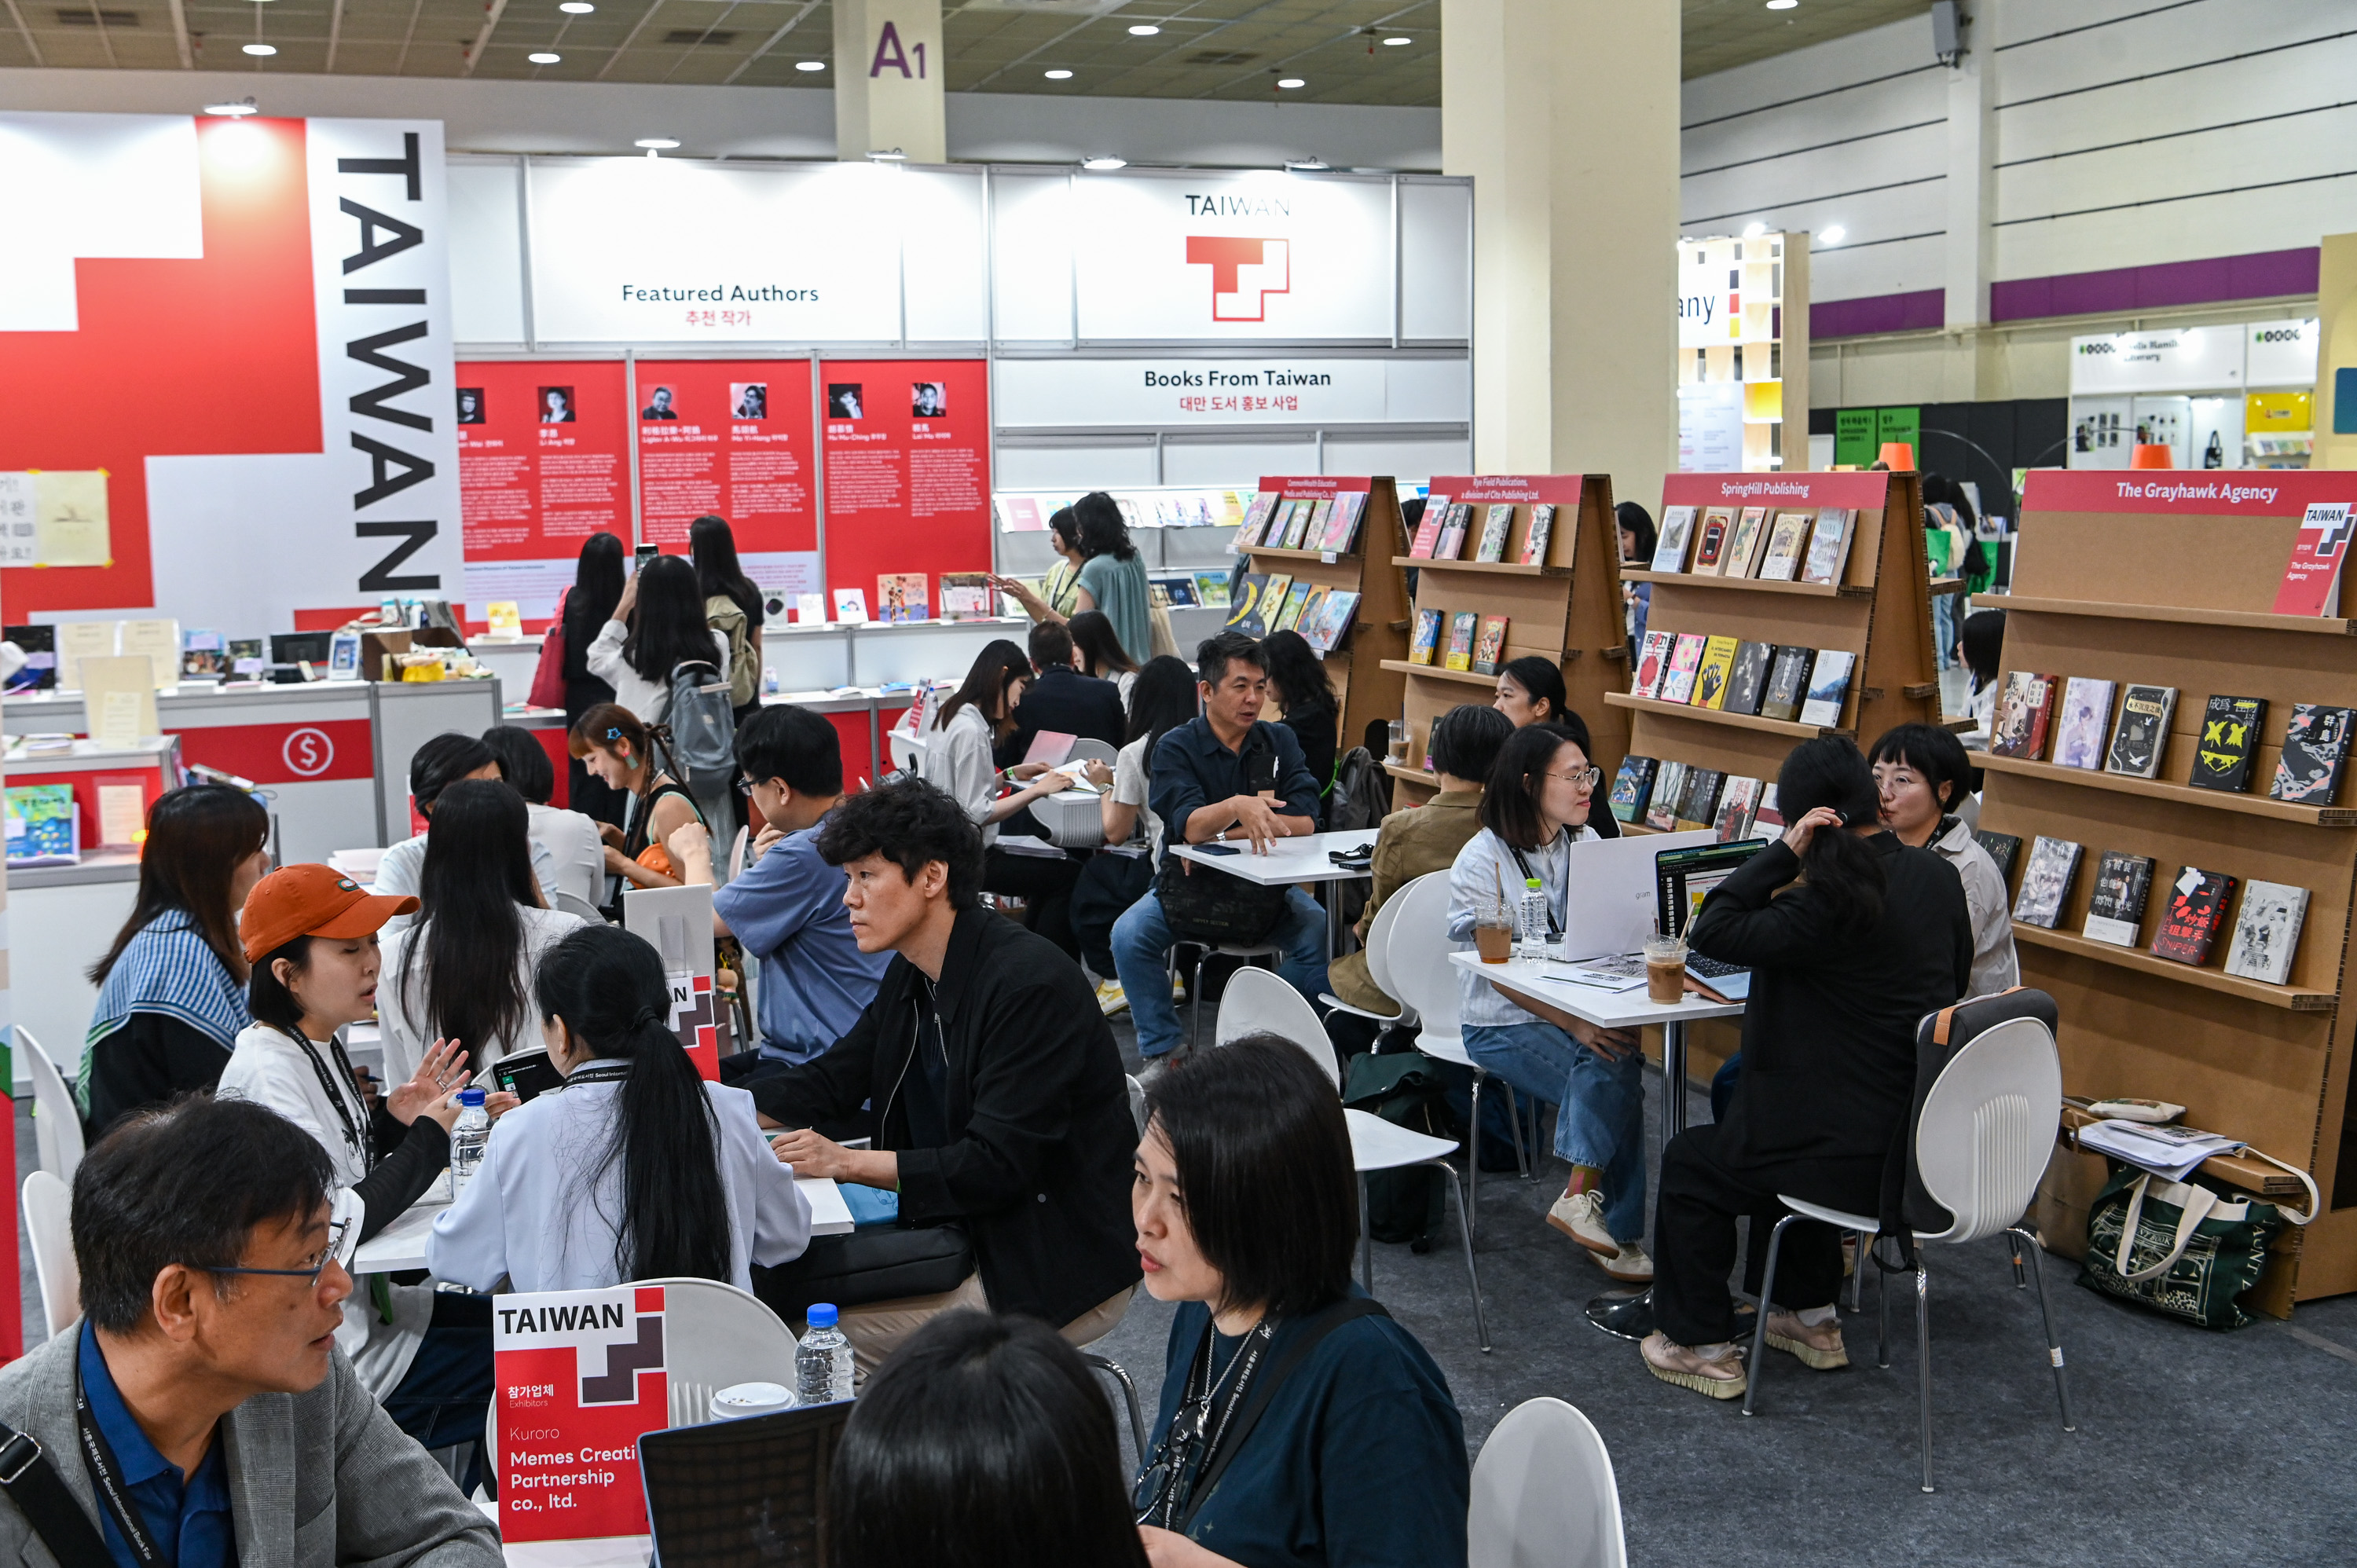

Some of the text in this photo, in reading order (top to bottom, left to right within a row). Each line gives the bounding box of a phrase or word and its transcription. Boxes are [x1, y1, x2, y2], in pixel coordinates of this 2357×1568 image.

[870, 20, 925, 79] A1
[1186, 195, 1290, 217] TAIWAN
[623, 284, 819, 302] Featured Authors
[686, 310, 752, 327] 추천 작가
[338, 133, 440, 592] TAIWAN
[1145, 369, 1331, 387] Books From Taiwan
[1180, 394, 1299, 412] 대만 도서 홍보 사업
[1473, 477, 1528, 489] Rye Field Publications,
[1721, 482, 1810, 499] SpringHill Publishing
[1464, 490, 1483, 499] division
[1484, 490, 1490, 499] of
[1490, 490, 1501, 499] Cite
[1501, 490, 1528, 502] Publishing
[2117, 482, 2278, 504] The Grayhawk Agency
[2306, 509, 2344, 522] TAIWAN
[2302, 562, 2330, 571] Grayhawk
[2286, 572, 2308, 581] Agency
[1635, 891, 1651, 900] gram
[2184, 914, 2210, 928] 炒飯
[2168, 924, 2205, 942] 狙擊手
[2160, 936, 2197, 955] SNIPER
[498, 1302, 624, 1335] TAIWAN
[508, 1383, 555, 1399] 참가업체
[509, 1398, 548, 1409] Exhibitors
[510, 1427, 560, 1441] Kuroro
[511, 1445, 636, 1467] Memes Creati
[511, 1468, 615, 1489] Partnership
[511, 1493, 577, 1512] co., ltd.
[103, 1475, 118, 1498] Seoul
[113, 1494, 137, 1537] International
[133, 1531, 147, 1550] Book
[141, 1545, 152, 1561] Fair
